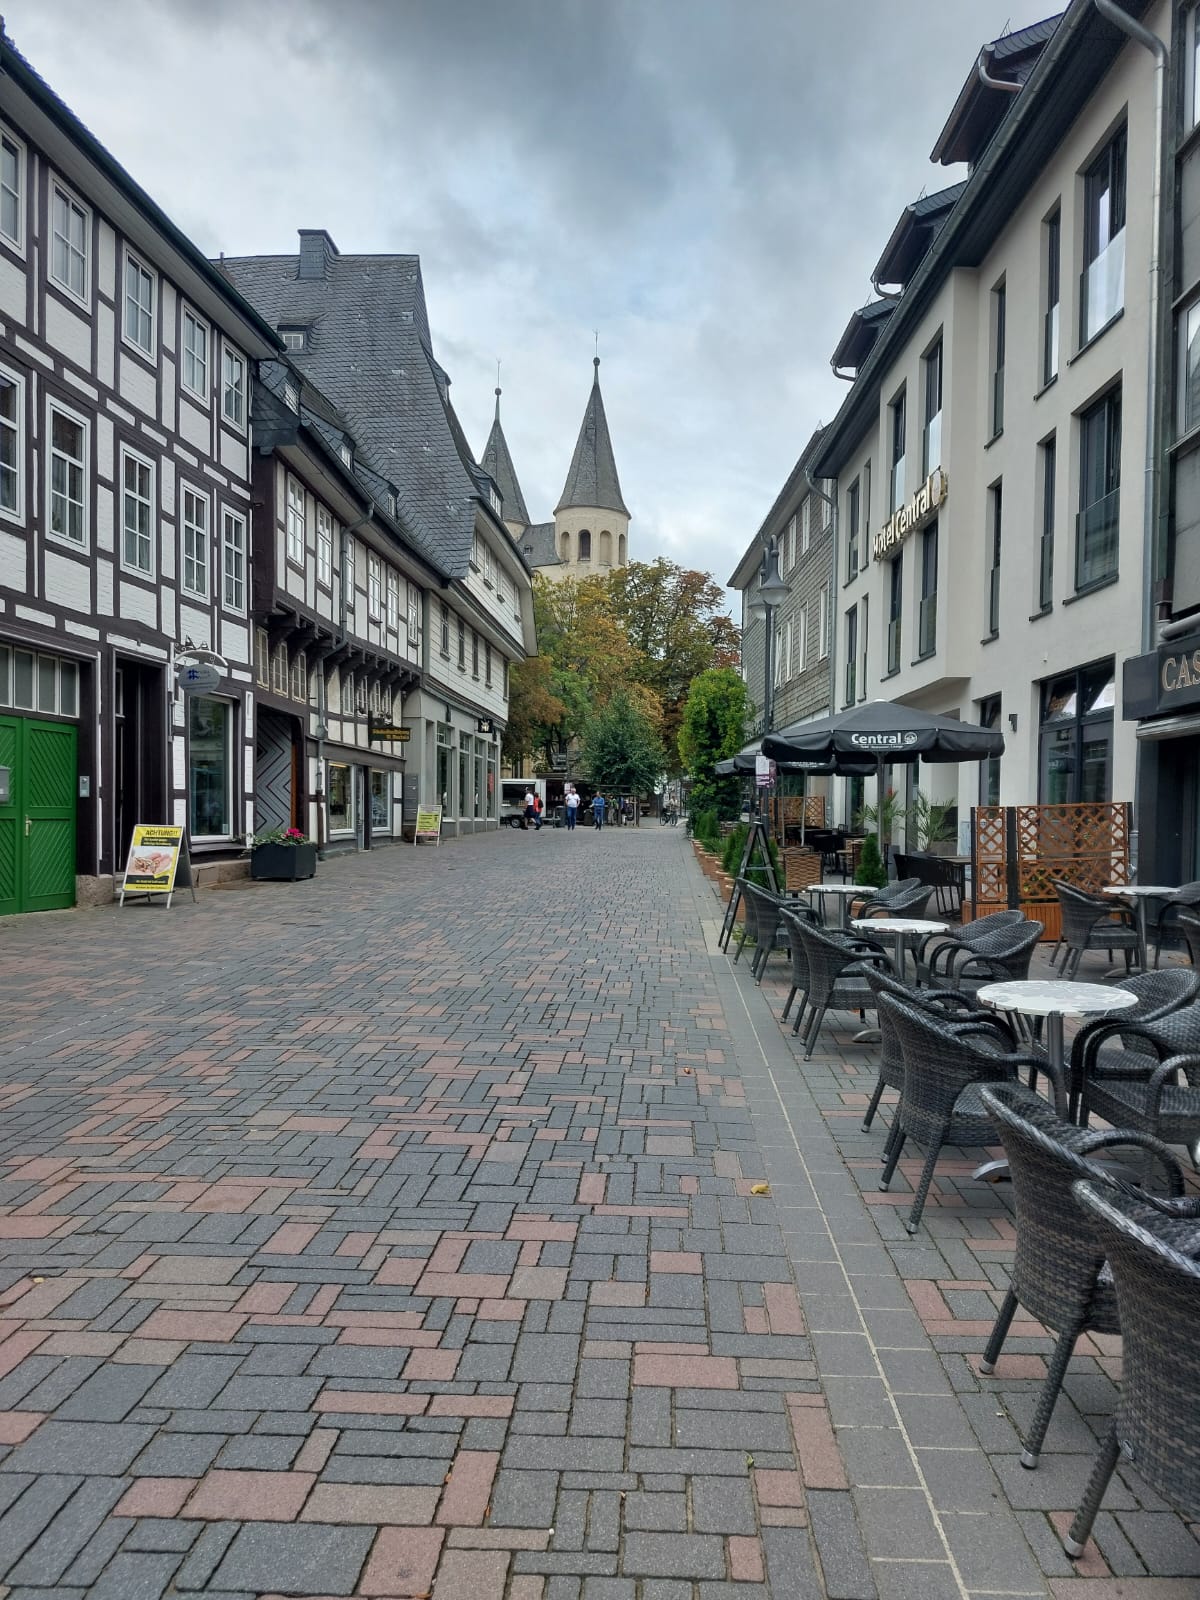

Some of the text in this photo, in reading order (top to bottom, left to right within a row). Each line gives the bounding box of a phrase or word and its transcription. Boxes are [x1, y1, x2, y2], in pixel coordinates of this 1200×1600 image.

[873, 476, 931, 555] Hotel Central
[851, 732, 902, 744] Central
